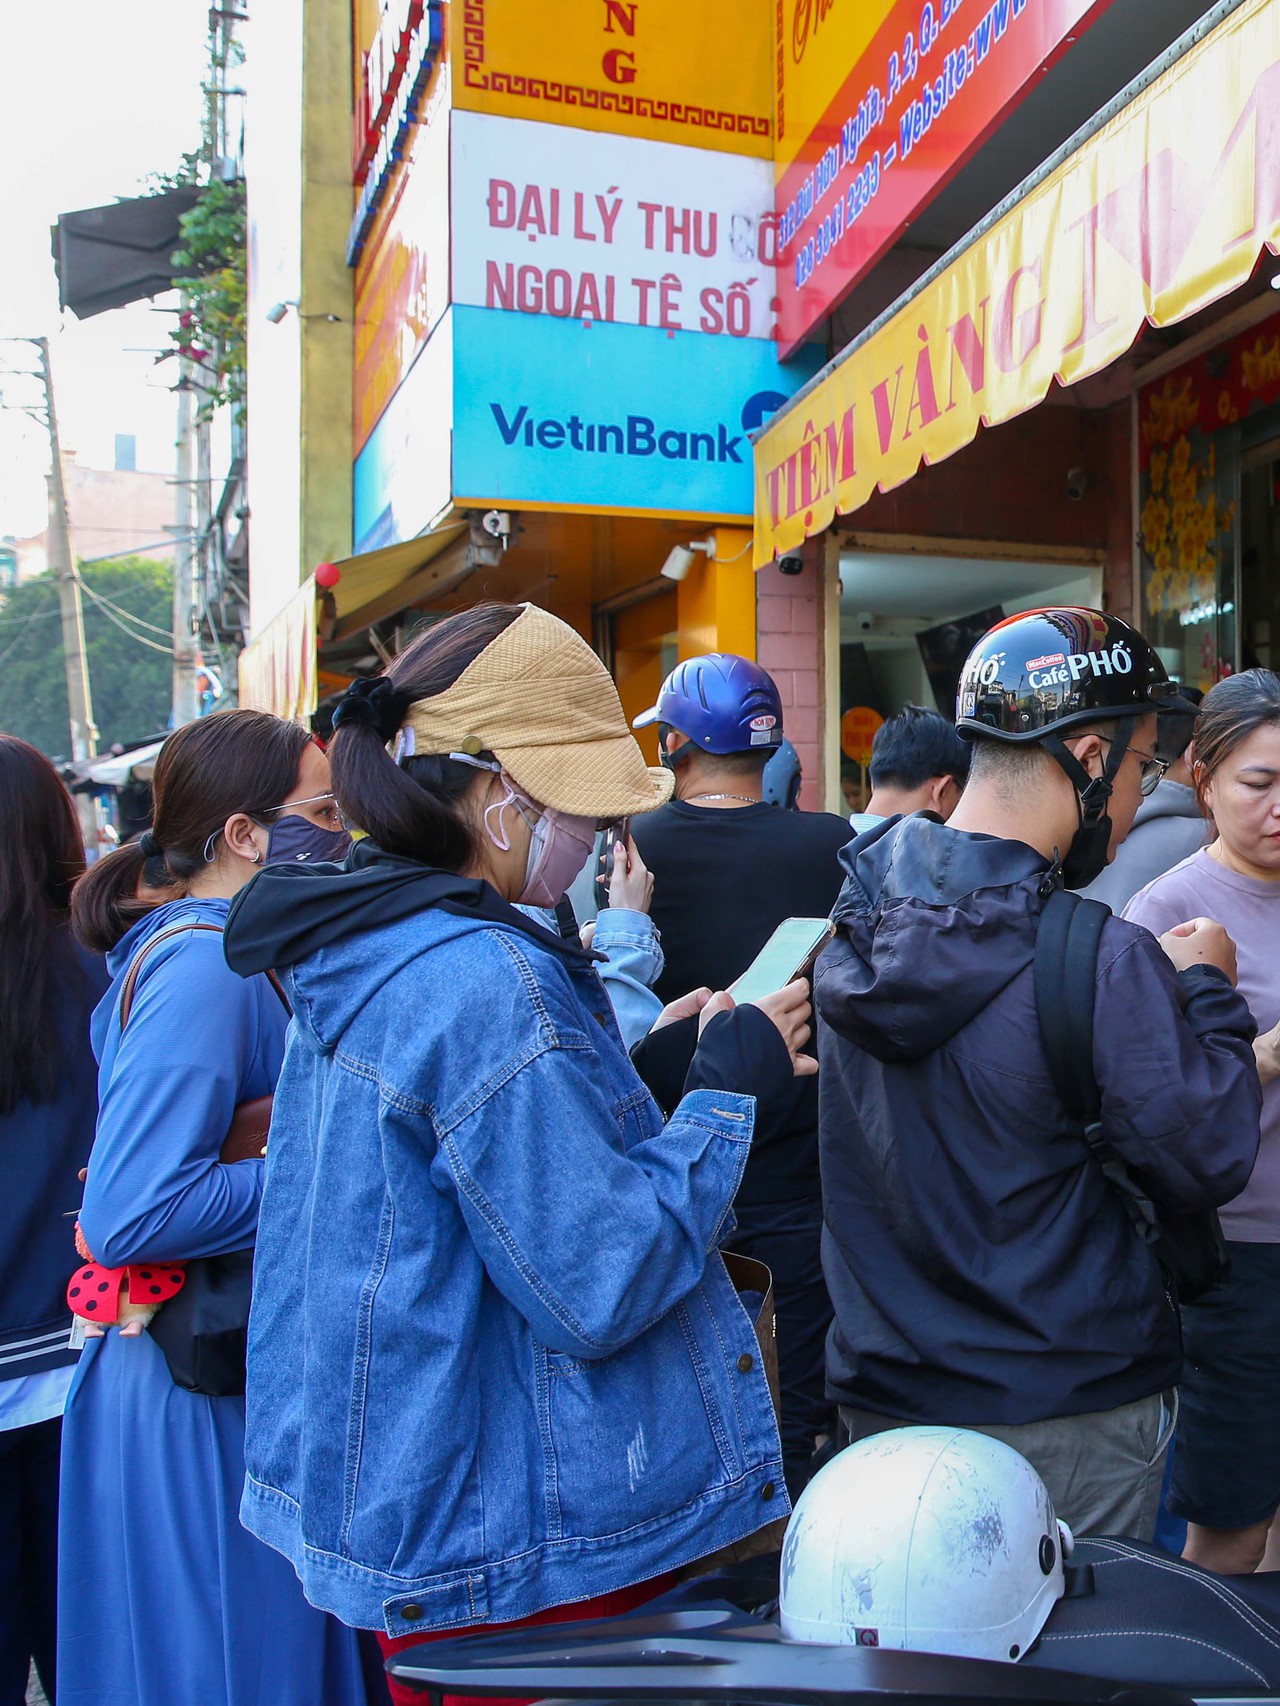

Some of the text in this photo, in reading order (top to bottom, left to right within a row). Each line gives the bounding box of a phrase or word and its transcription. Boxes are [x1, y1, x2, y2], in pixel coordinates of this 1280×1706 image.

[796, 171, 814, 230] Bùi
[815, 143, 840, 204] Hữu
[841, 84, 885, 169] Nghĩa,
[486, 177, 559, 242] ĐẠI
[573, 185, 623, 244] LÝ
[637, 201, 717, 258] THU
[795, 236, 815, 291] 028
[846, 150, 881, 229] 2233
[486, 260, 758, 338] NGOẠI TỆ SỐ
[489, 402, 743, 464] VietinBank
[766, 402, 857, 533] TIỆM
[870, 255, 1046, 456] VÀNG
[1029, 640, 1132, 688] Café PHỐ
